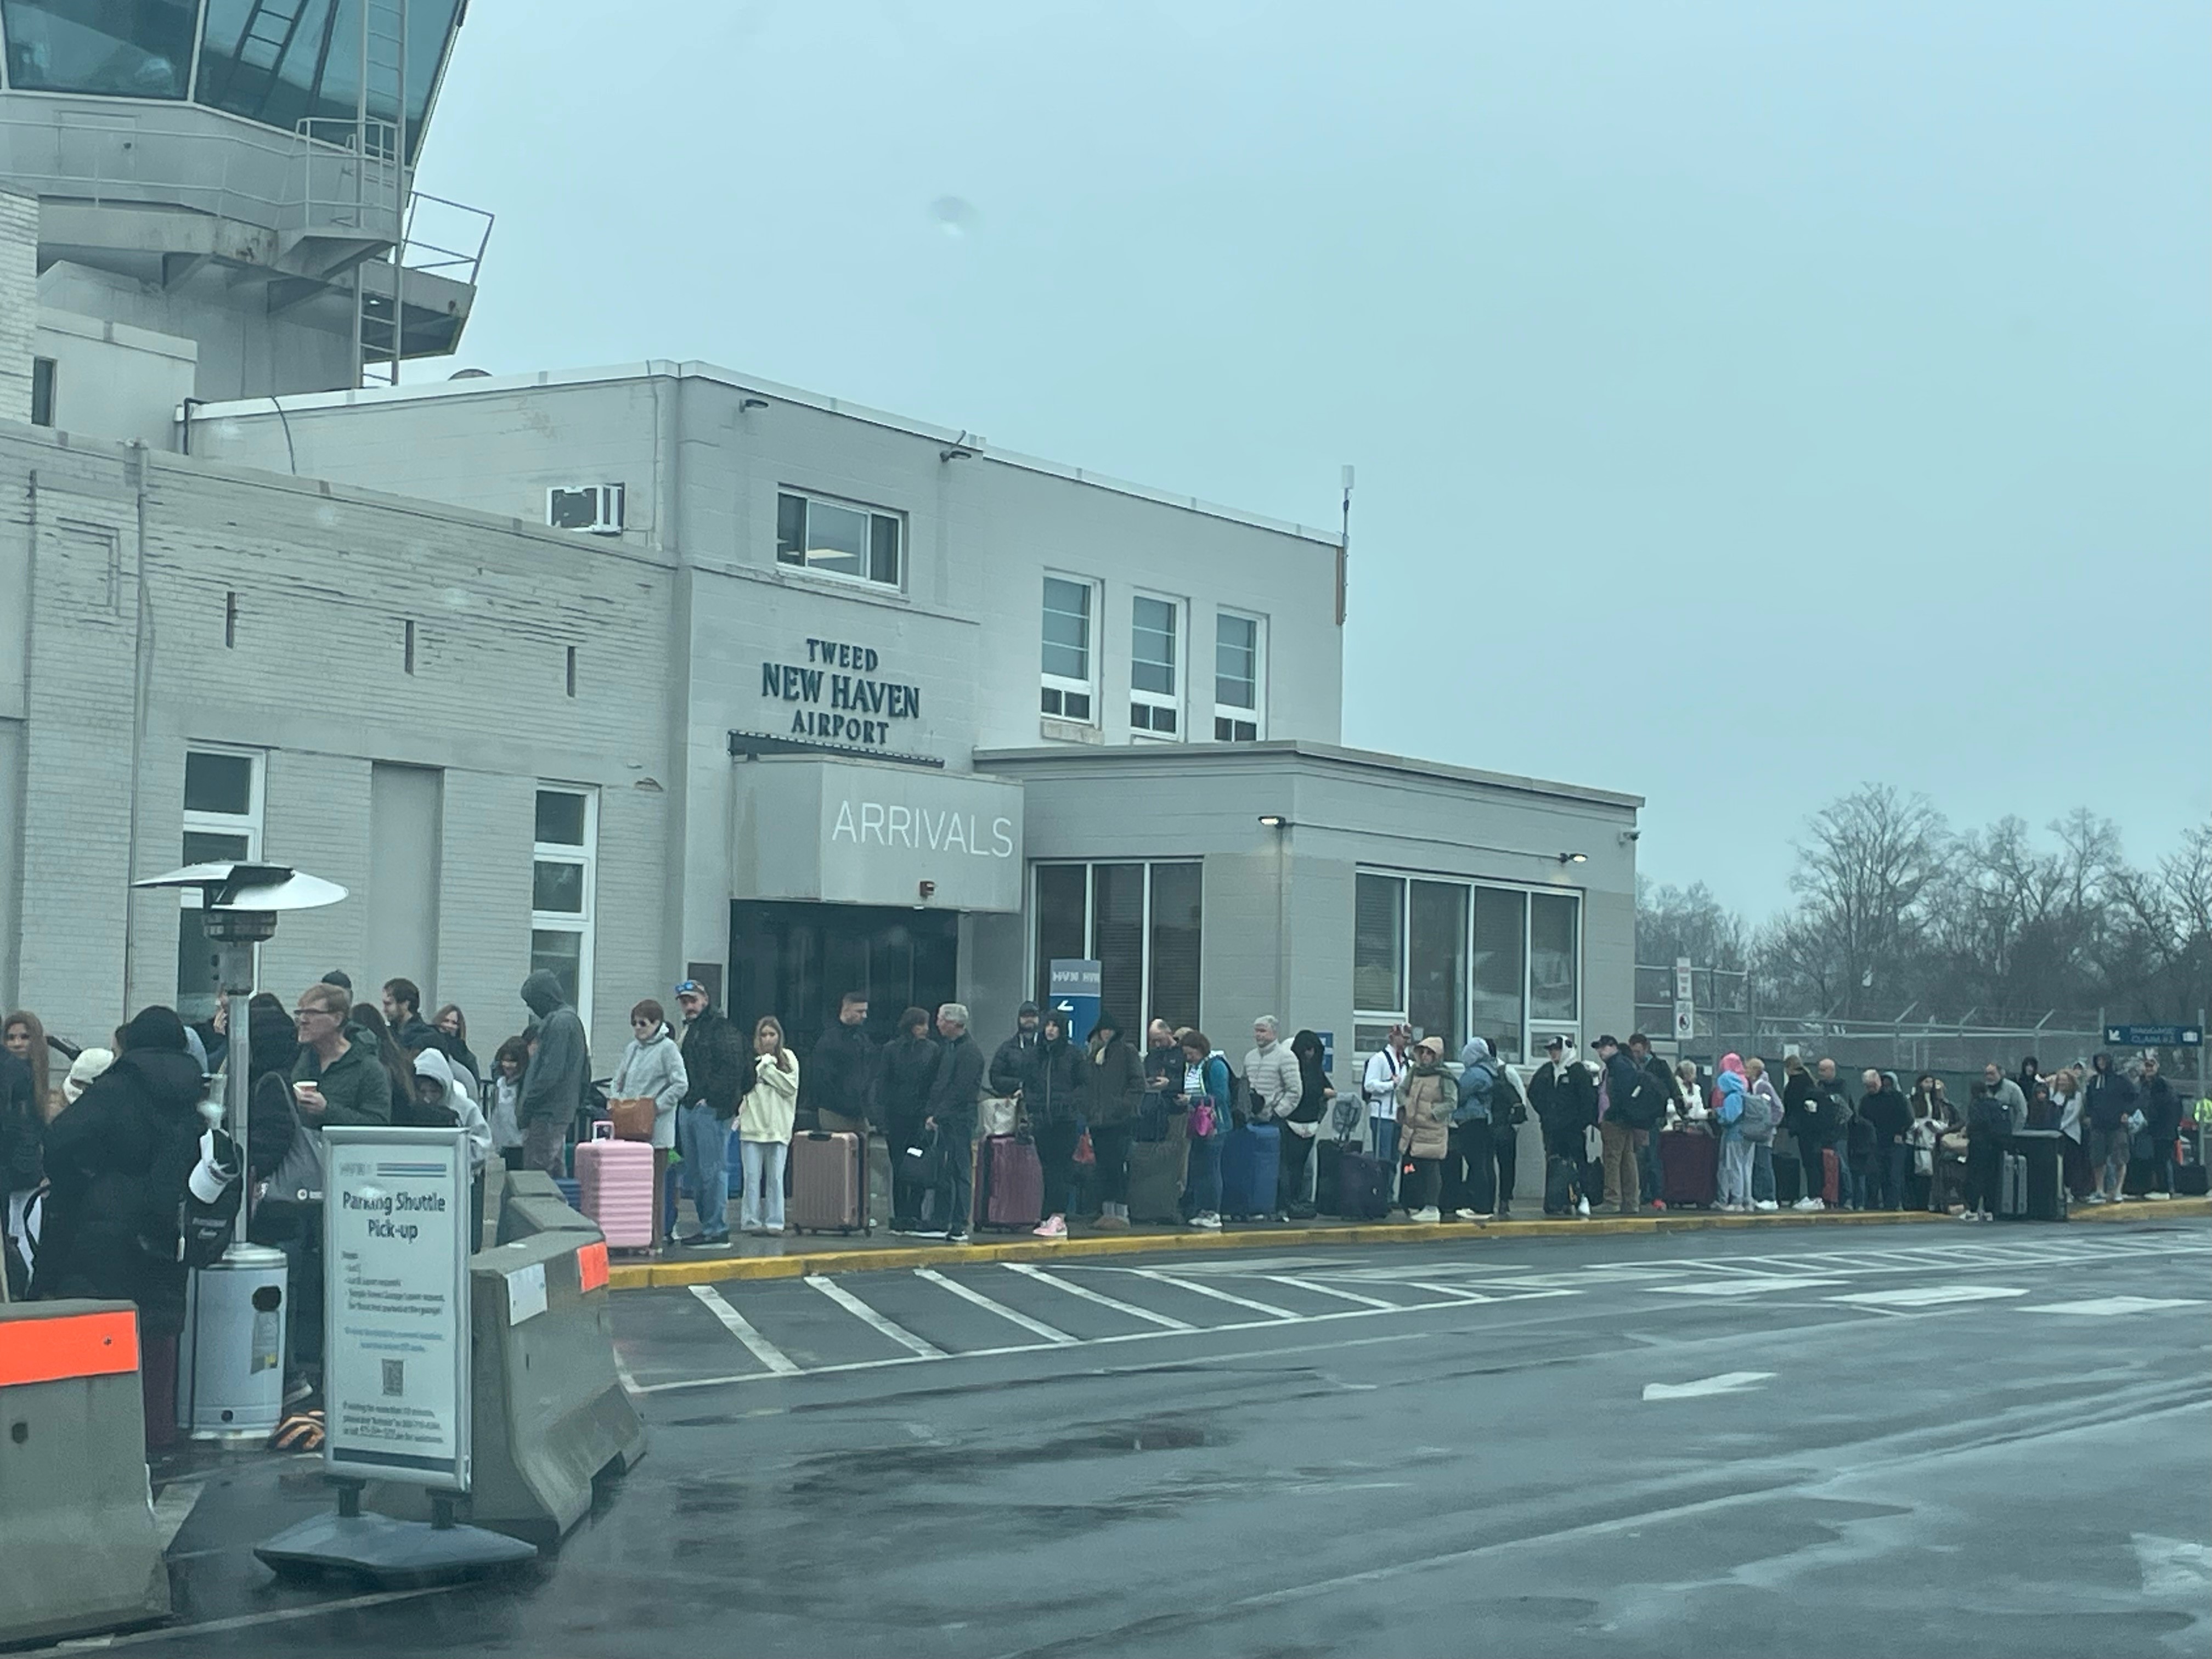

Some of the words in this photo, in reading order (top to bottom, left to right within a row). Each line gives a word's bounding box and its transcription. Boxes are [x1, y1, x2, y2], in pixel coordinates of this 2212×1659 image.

[806, 638, 878, 672] TWEED
[761, 662, 824, 703] NEW
[831, 674, 921, 719] HAVEN
[791, 709, 889, 744] AIRPORT
[832, 800, 1013, 858] ARRIVALS
[1052, 971, 1079, 982] HVN
[343, 1190, 392, 1216] Parking
[396, 1192, 446, 1212] Shuttle
[368, 1218, 419, 1244] Pick-up
